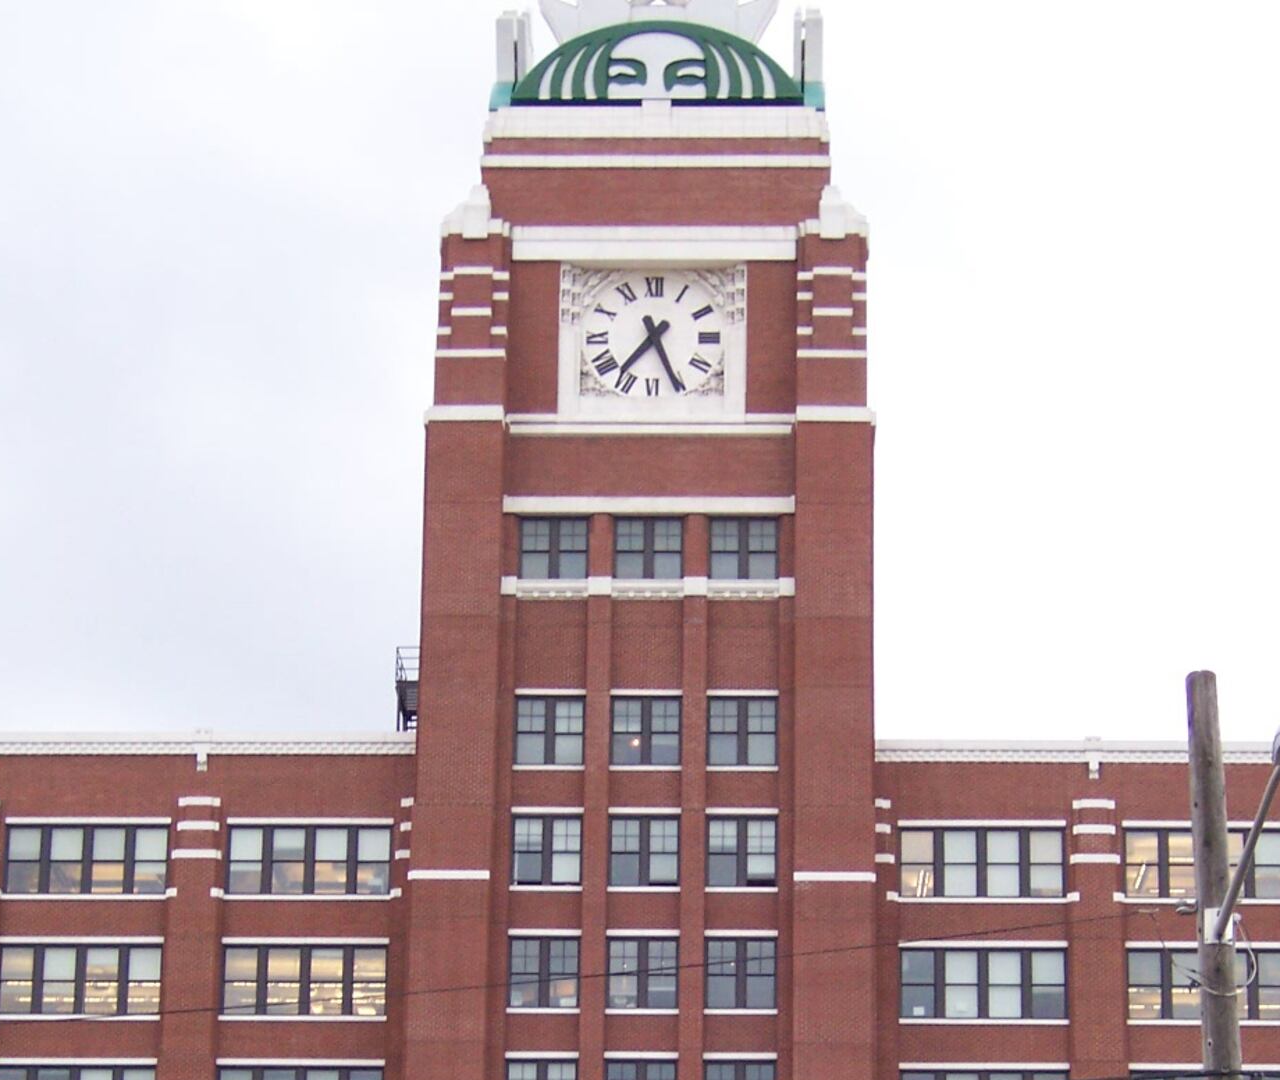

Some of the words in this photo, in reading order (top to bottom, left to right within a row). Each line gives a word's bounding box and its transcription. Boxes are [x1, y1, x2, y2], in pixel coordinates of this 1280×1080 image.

[615, 282, 638, 305] XI
[645, 277, 664, 297] XII
[675, 284, 690, 303] I
[593, 303, 617, 321] X
[691, 304, 714, 321] II
[586, 331, 608, 344] IX
[698, 332, 720, 344] III
[591, 348, 619, 376] VIII
[688, 353, 712, 374] IV
[614, 371, 638, 394] VII
[645, 378, 659, 396] VI
